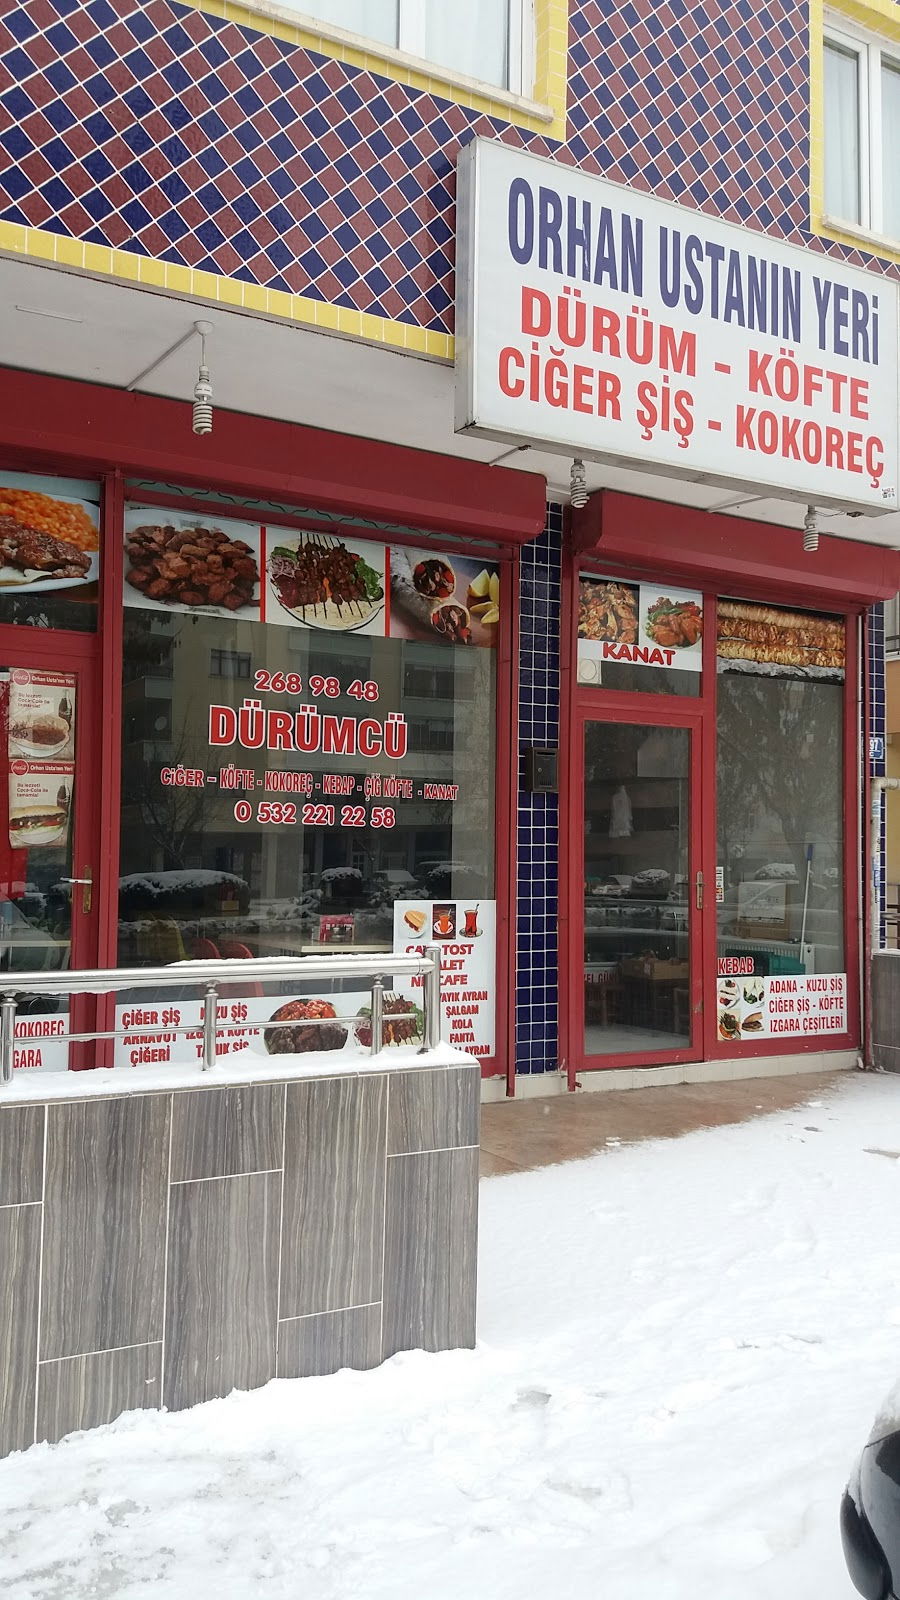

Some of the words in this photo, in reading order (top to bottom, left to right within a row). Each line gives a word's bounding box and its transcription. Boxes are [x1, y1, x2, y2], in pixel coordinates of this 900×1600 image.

[508, 177, 643, 297] ORHAN
[659, 226, 801, 343] USTANIN
[521, 286, 696, 377] DÜRÜM
[748, 348, 869, 420] KÖFTE
[498, 342, 621, 421] CİĞER
[637, 375, 694, 449] ŞİŞ
[736, 404, 885, 489] KOKOREÇ
[602, 641, 677, 666] KANAT
[255, 669, 302, 694] 268
[309, 675, 341, 698] 98
[347, 680, 379, 702] 48
[208, 698, 408, 759] DÜRÜMCÜ
[220, 763, 254, 790] KÖFTE
[265, 770, 313, 798] KOKOREÇ
[323, 774, 355, 795] KEBAP
[383, 774, 413, 798] KÖFTE
[424, 783, 459, 800] KANAT
[257, 802, 296, 824] 532
[302, 803, 335, 826] 221
[341, 805, 366, 827] 22
[370, 807, 395, 828] 58
[442, 944, 474, 956] TOST
[717, 956, 754, 975] KEBAB
[769, 980, 798, 994] ADANA
[806, 979, 828, 992] KUZU
[830, 975, 843, 994] ŞİŞ
[462, 991, 488, 1001] AYRAN
[769, 997, 794, 1013] CİĞER
[797, 996, 810, 1015] ŞİŞ
[818, 994, 844, 1011] KÖFTE
[122, 1009, 159, 1029] ÇİĞER
[162, 1007, 181, 1027] ŞİŞ
[231, 1002, 248, 1021] ŞİŞ
[446, 1005, 479, 1018] ŞALGAM
[452, 1019, 473, 1029] KOLA
[770, 1018, 800, 1033] IZGARA
[803, 1013, 844, 1034] ÇEŞİTLERİ
[450, 1032, 475, 1043] FANTA
[130, 1045, 170, 1067] ÇİĞERİ
